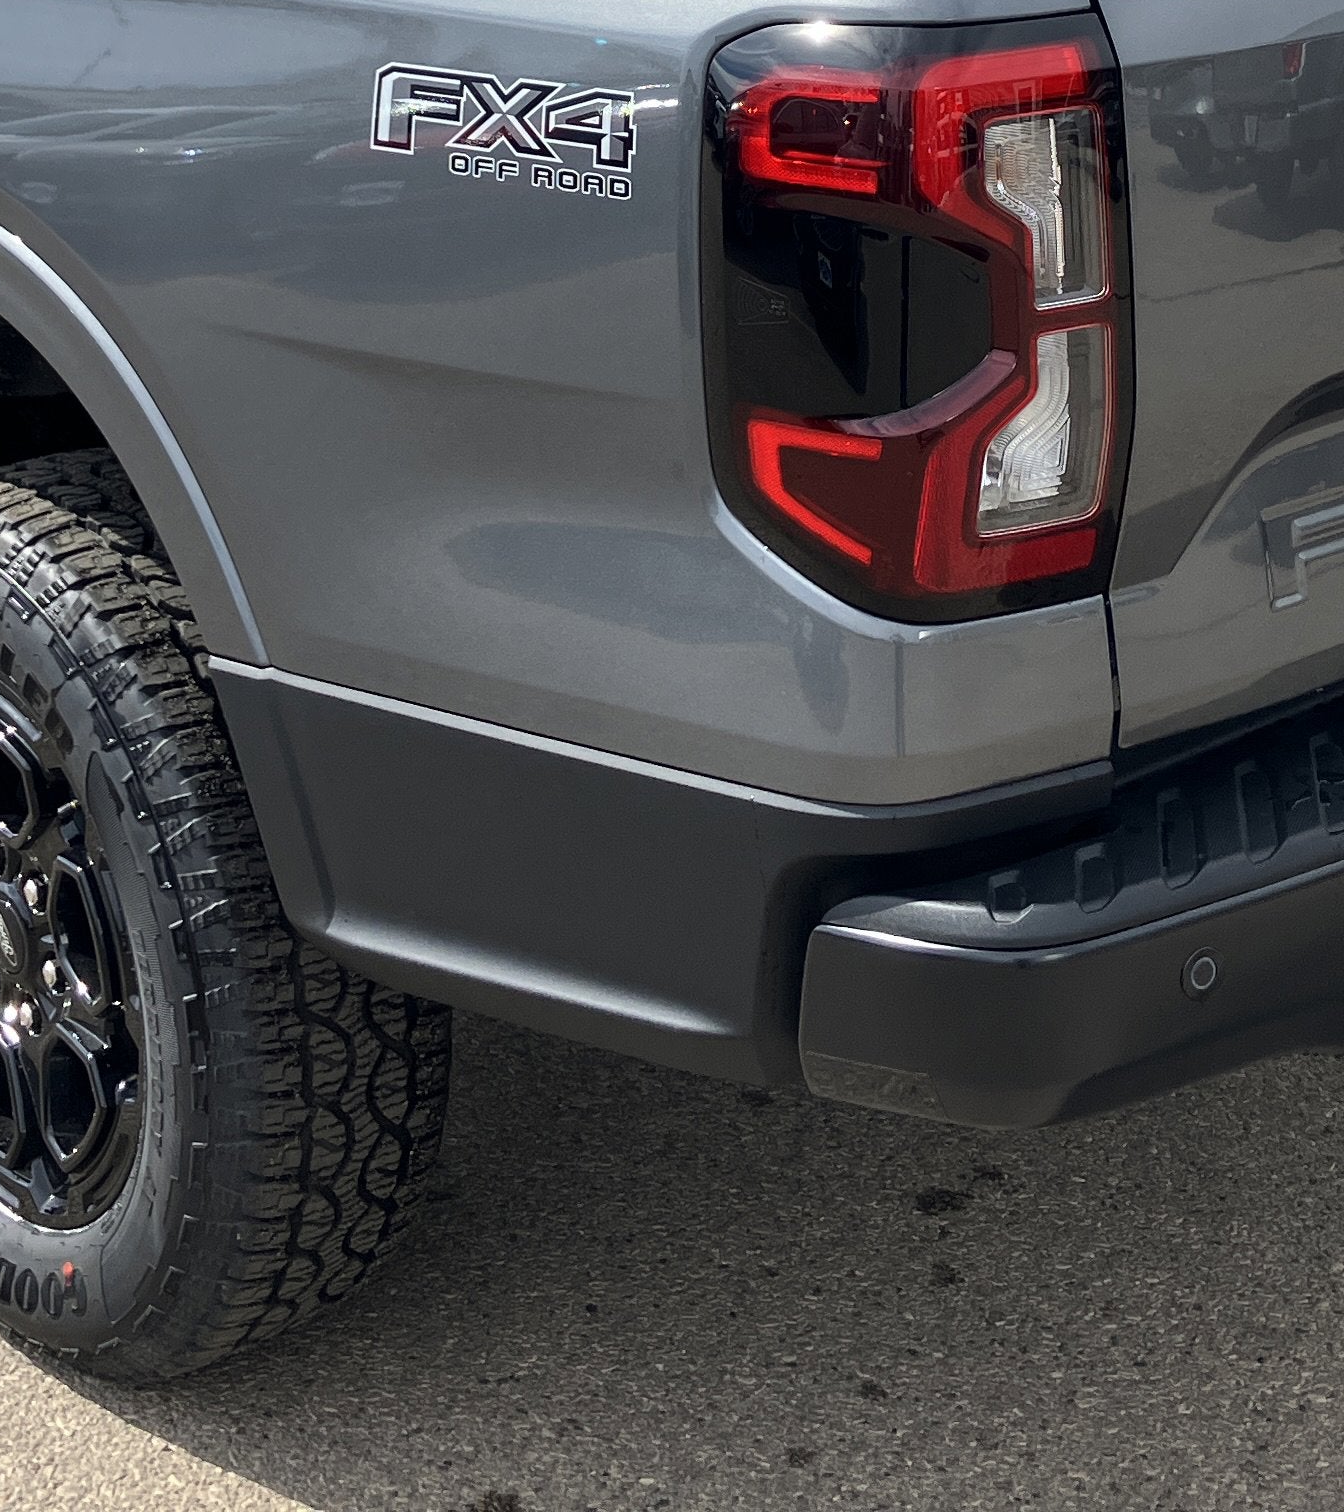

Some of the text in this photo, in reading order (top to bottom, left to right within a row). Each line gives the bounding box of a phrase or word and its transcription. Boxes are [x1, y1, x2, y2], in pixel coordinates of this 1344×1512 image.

[370, 61, 636, 173] FX4
[449, 153, 632, 200] OFF ROAD
